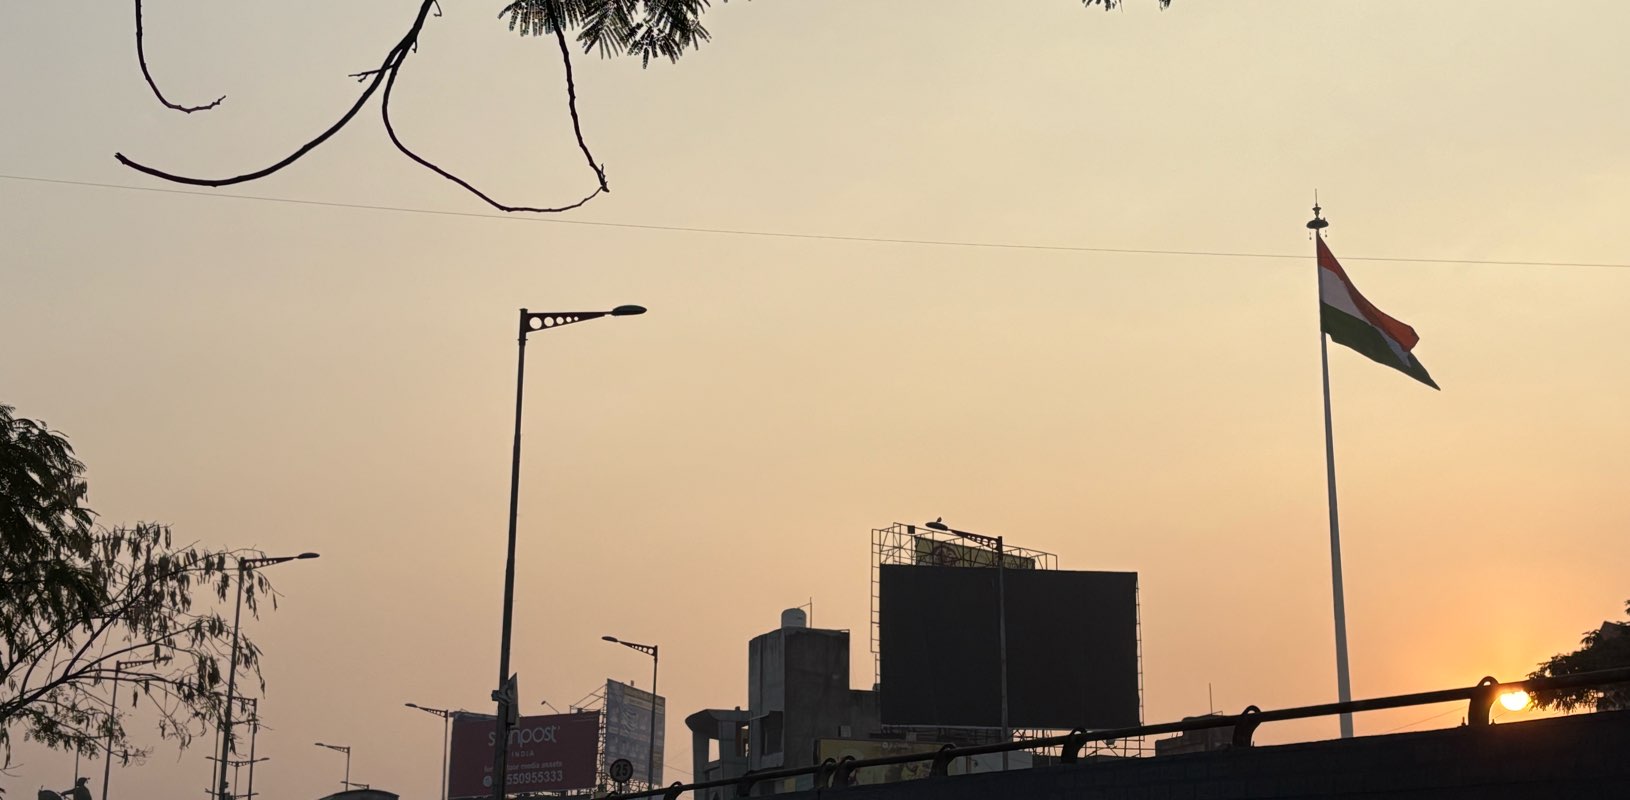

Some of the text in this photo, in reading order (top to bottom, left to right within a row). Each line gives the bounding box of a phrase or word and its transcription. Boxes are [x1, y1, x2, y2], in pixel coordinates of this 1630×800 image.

[488, 725, 557, 748] snpost
[511, 750, 535, 758] INDIA
[506, 770, 563, 785] 550955333
[615, 764, 629, 777] 25
